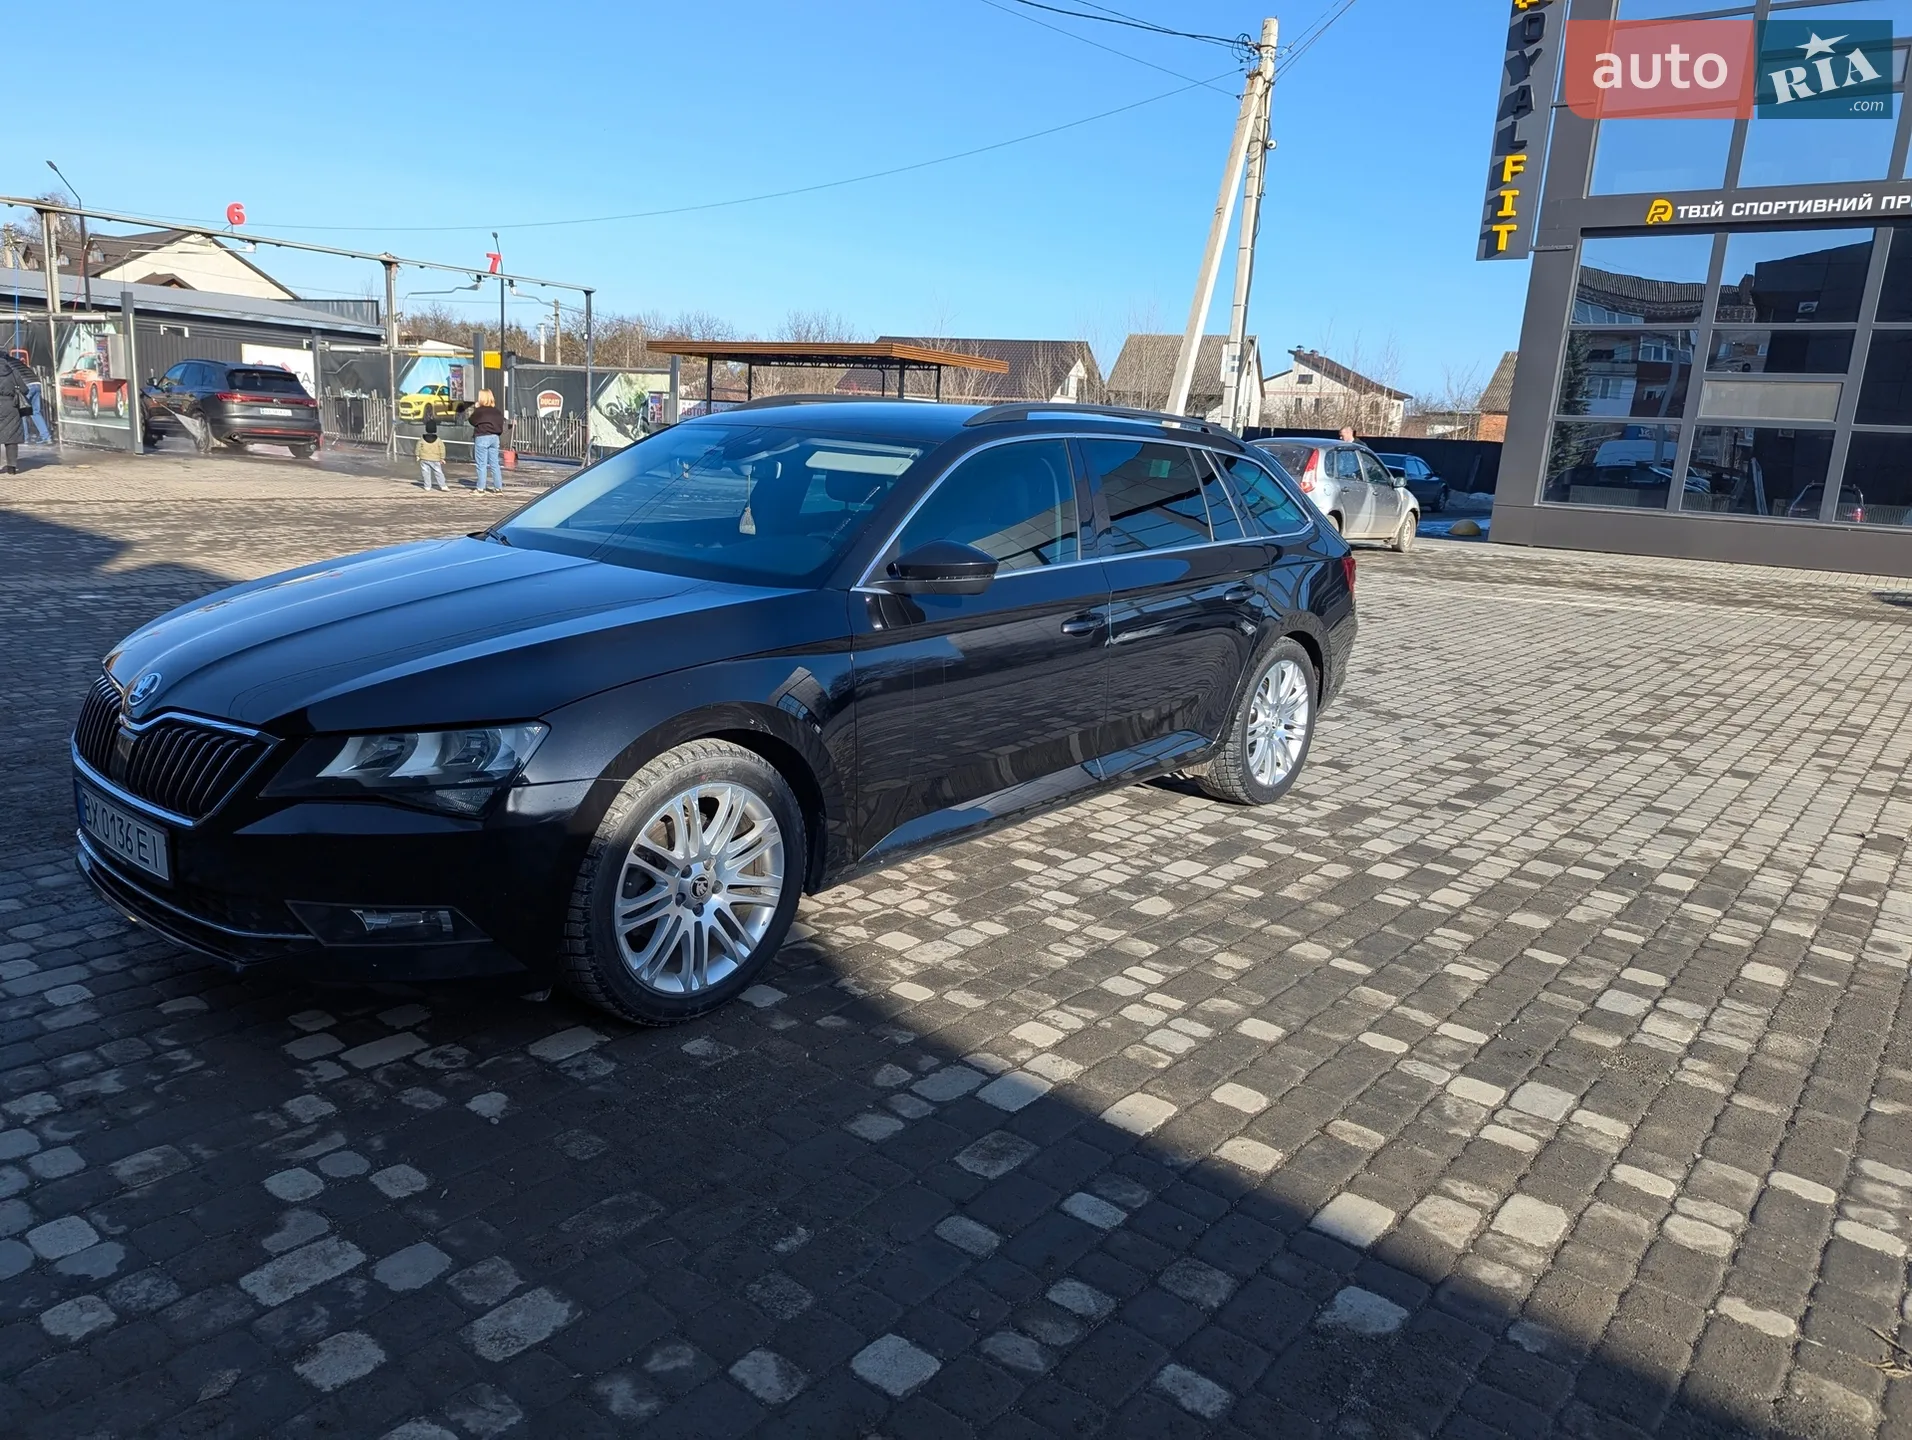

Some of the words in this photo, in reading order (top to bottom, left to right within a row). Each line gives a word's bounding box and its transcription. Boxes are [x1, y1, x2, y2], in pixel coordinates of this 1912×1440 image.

[1508, 0, 1547, 149] OYAL
[227, 202, 245, 225] 6
[1492, 154, 1527, 251] FIT
[1677, 201, 1724, 219] ТВІЙ
[1731, 193, 1874, 216] СПОРТИВНИЙ
[1880, 194, 1912, 210] ПР
[486, 253, 502, 275] 7
